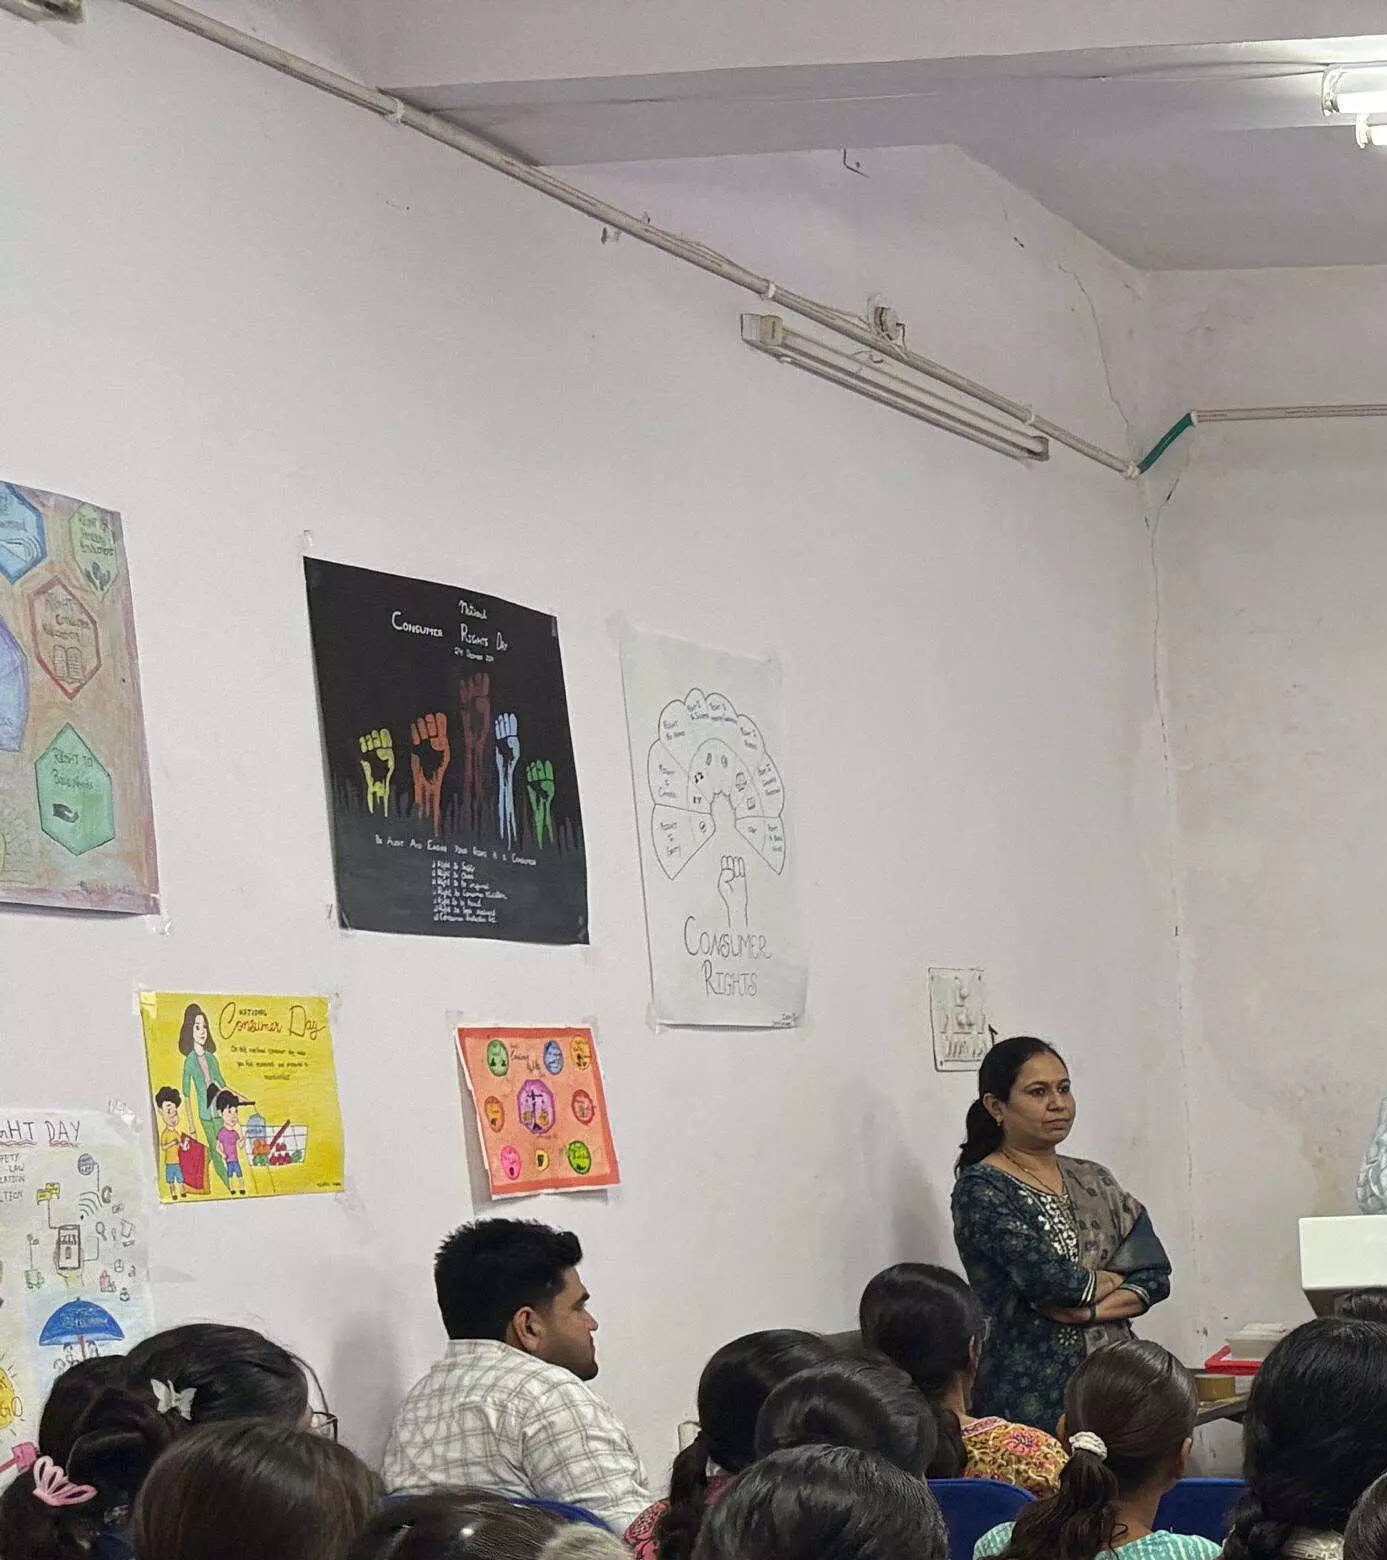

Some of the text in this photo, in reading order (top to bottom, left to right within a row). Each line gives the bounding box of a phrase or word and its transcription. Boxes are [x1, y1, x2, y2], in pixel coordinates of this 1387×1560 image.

[684, 915, 772, 960] CONSUMER
[701, 959, 758, 997] RIGHTS
[45, 1120, 80, 1142] DAY
